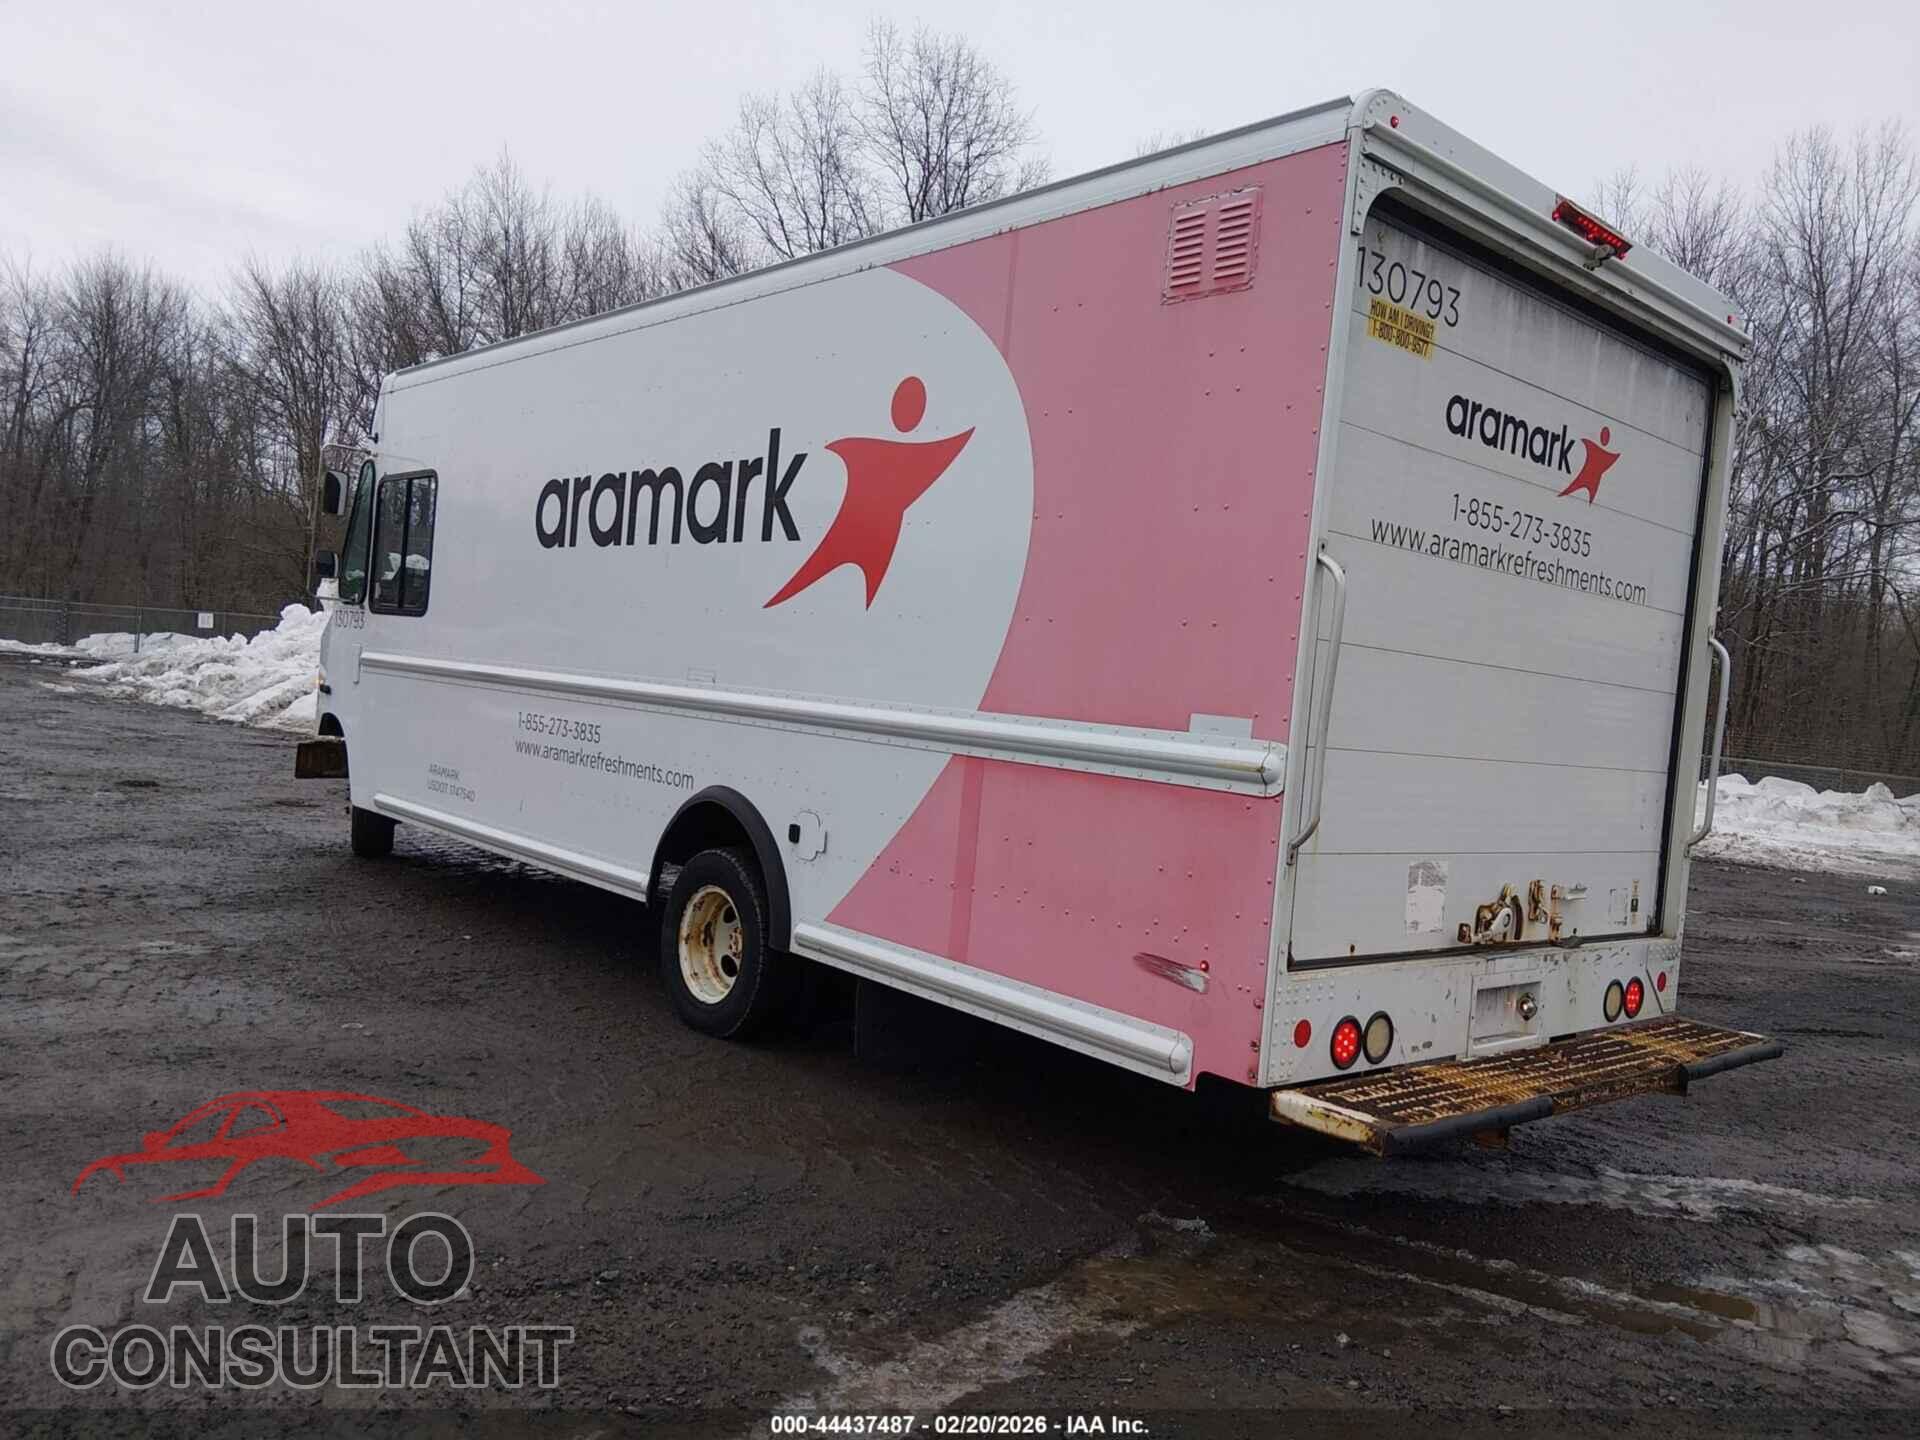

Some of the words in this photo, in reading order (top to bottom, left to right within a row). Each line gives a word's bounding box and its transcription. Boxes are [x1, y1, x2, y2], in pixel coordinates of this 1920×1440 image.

[1358, 246, 1460, 327] 130793
[1370, 298, 1388, 321] HOW
[1388, 306, 1400, 325] AM
[1404, 313, 1434, 340] DRIVING?
[1446, 394, 1575, 474] aramark
[536, 427, 808, 549] aramark
[1371, 518, 1646, 604] www.aramarkrefreshments.com
[1453, 493, 1592, 557] 1-855-273-3835
[517, 711, 601, 744] 1-855-273-3835
[515, 739, 695, 790] www.aramarkrefreshments.com
